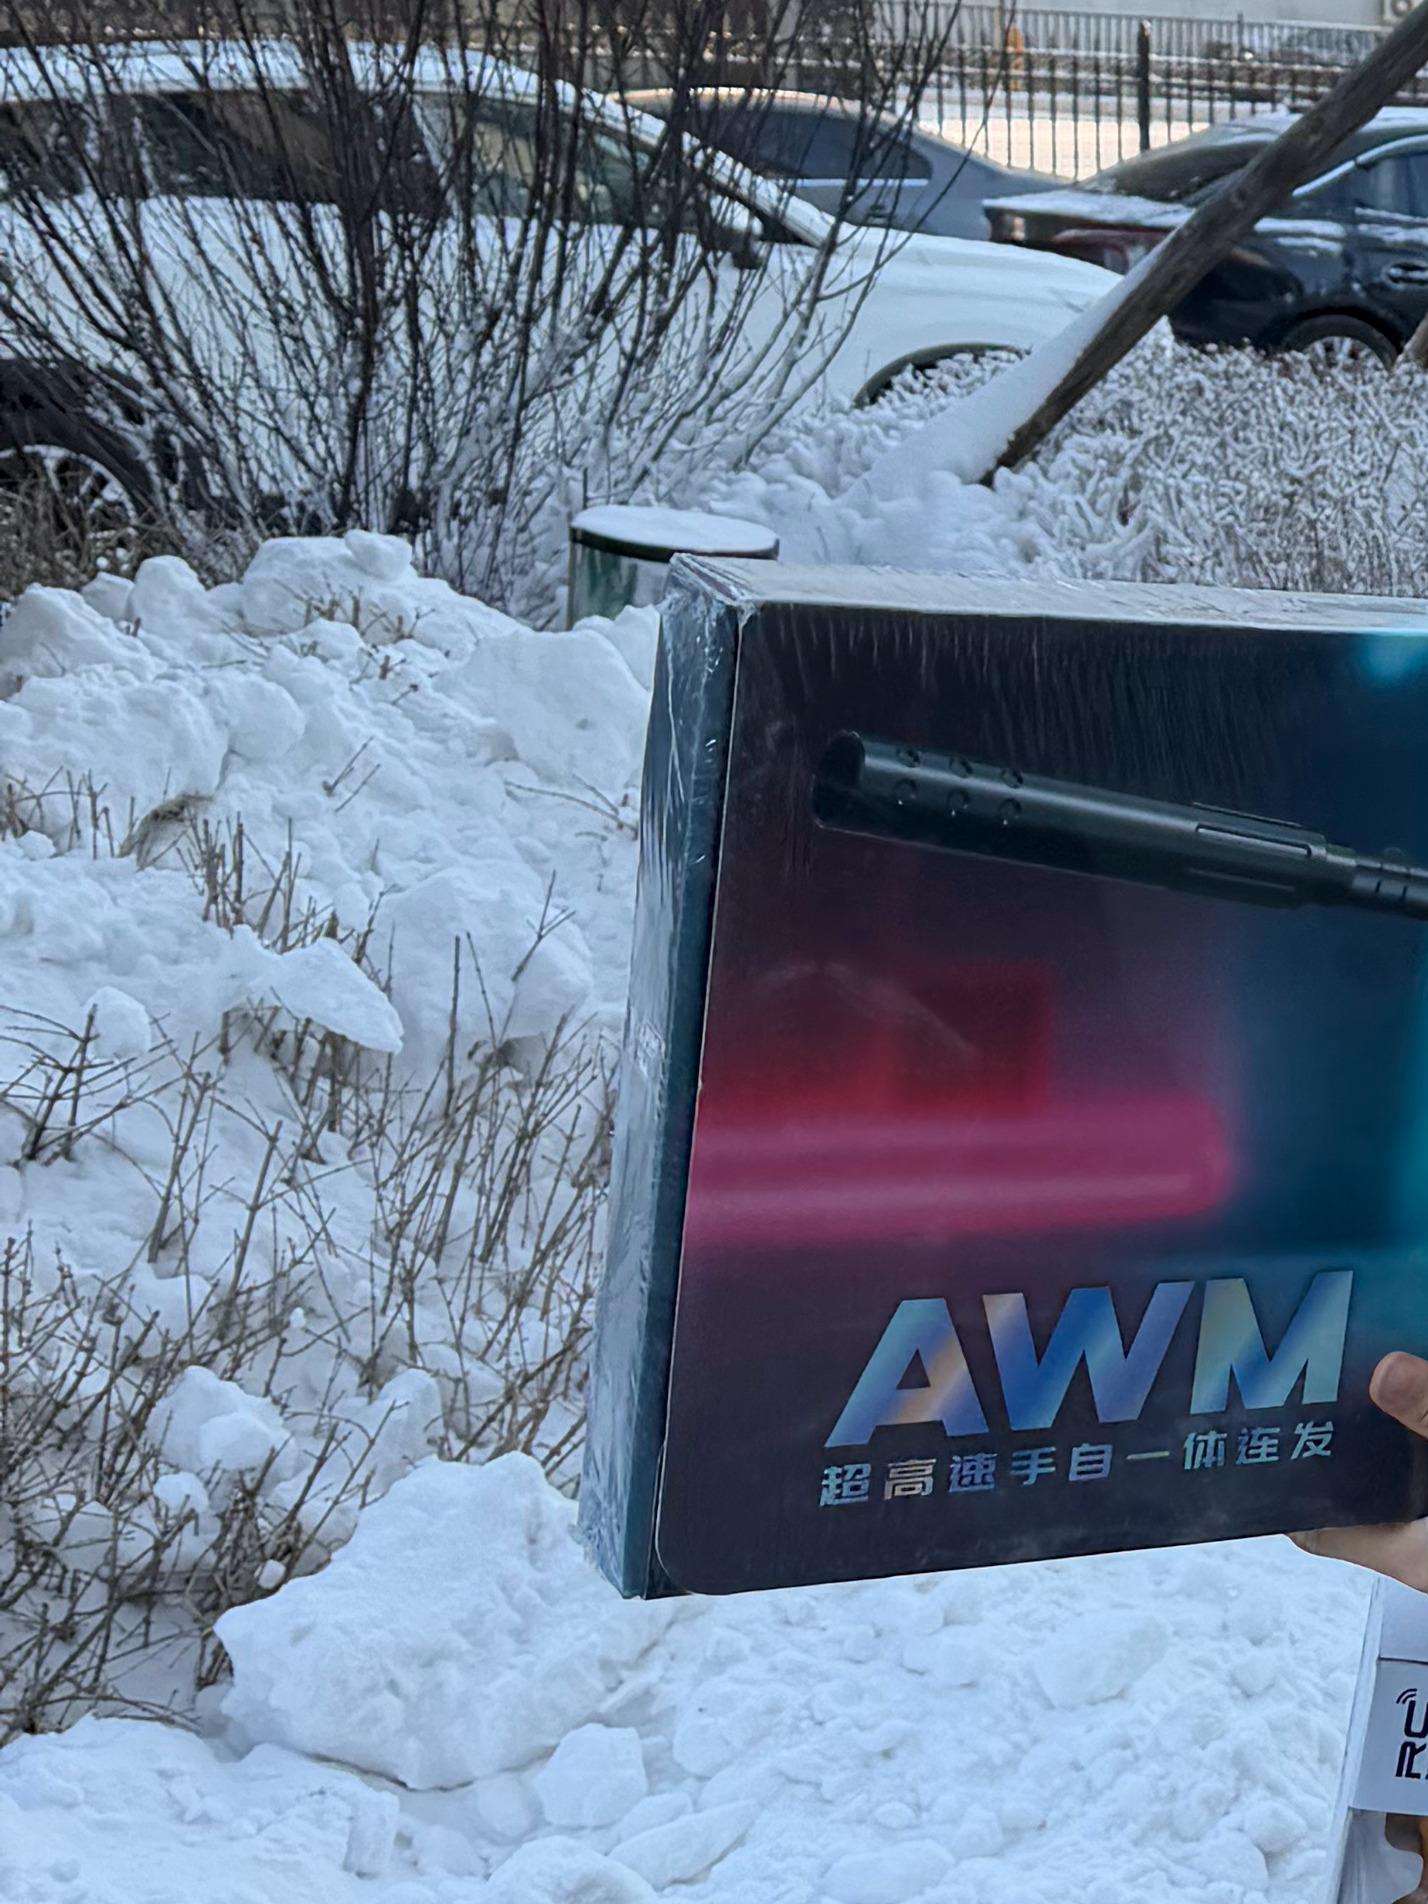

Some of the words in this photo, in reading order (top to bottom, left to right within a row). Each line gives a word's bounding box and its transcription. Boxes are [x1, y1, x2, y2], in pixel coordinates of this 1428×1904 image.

[825, 1270, 1354, 1448] AWM
[819, 1421, 1334, 1507] 超高速手自一体连发
